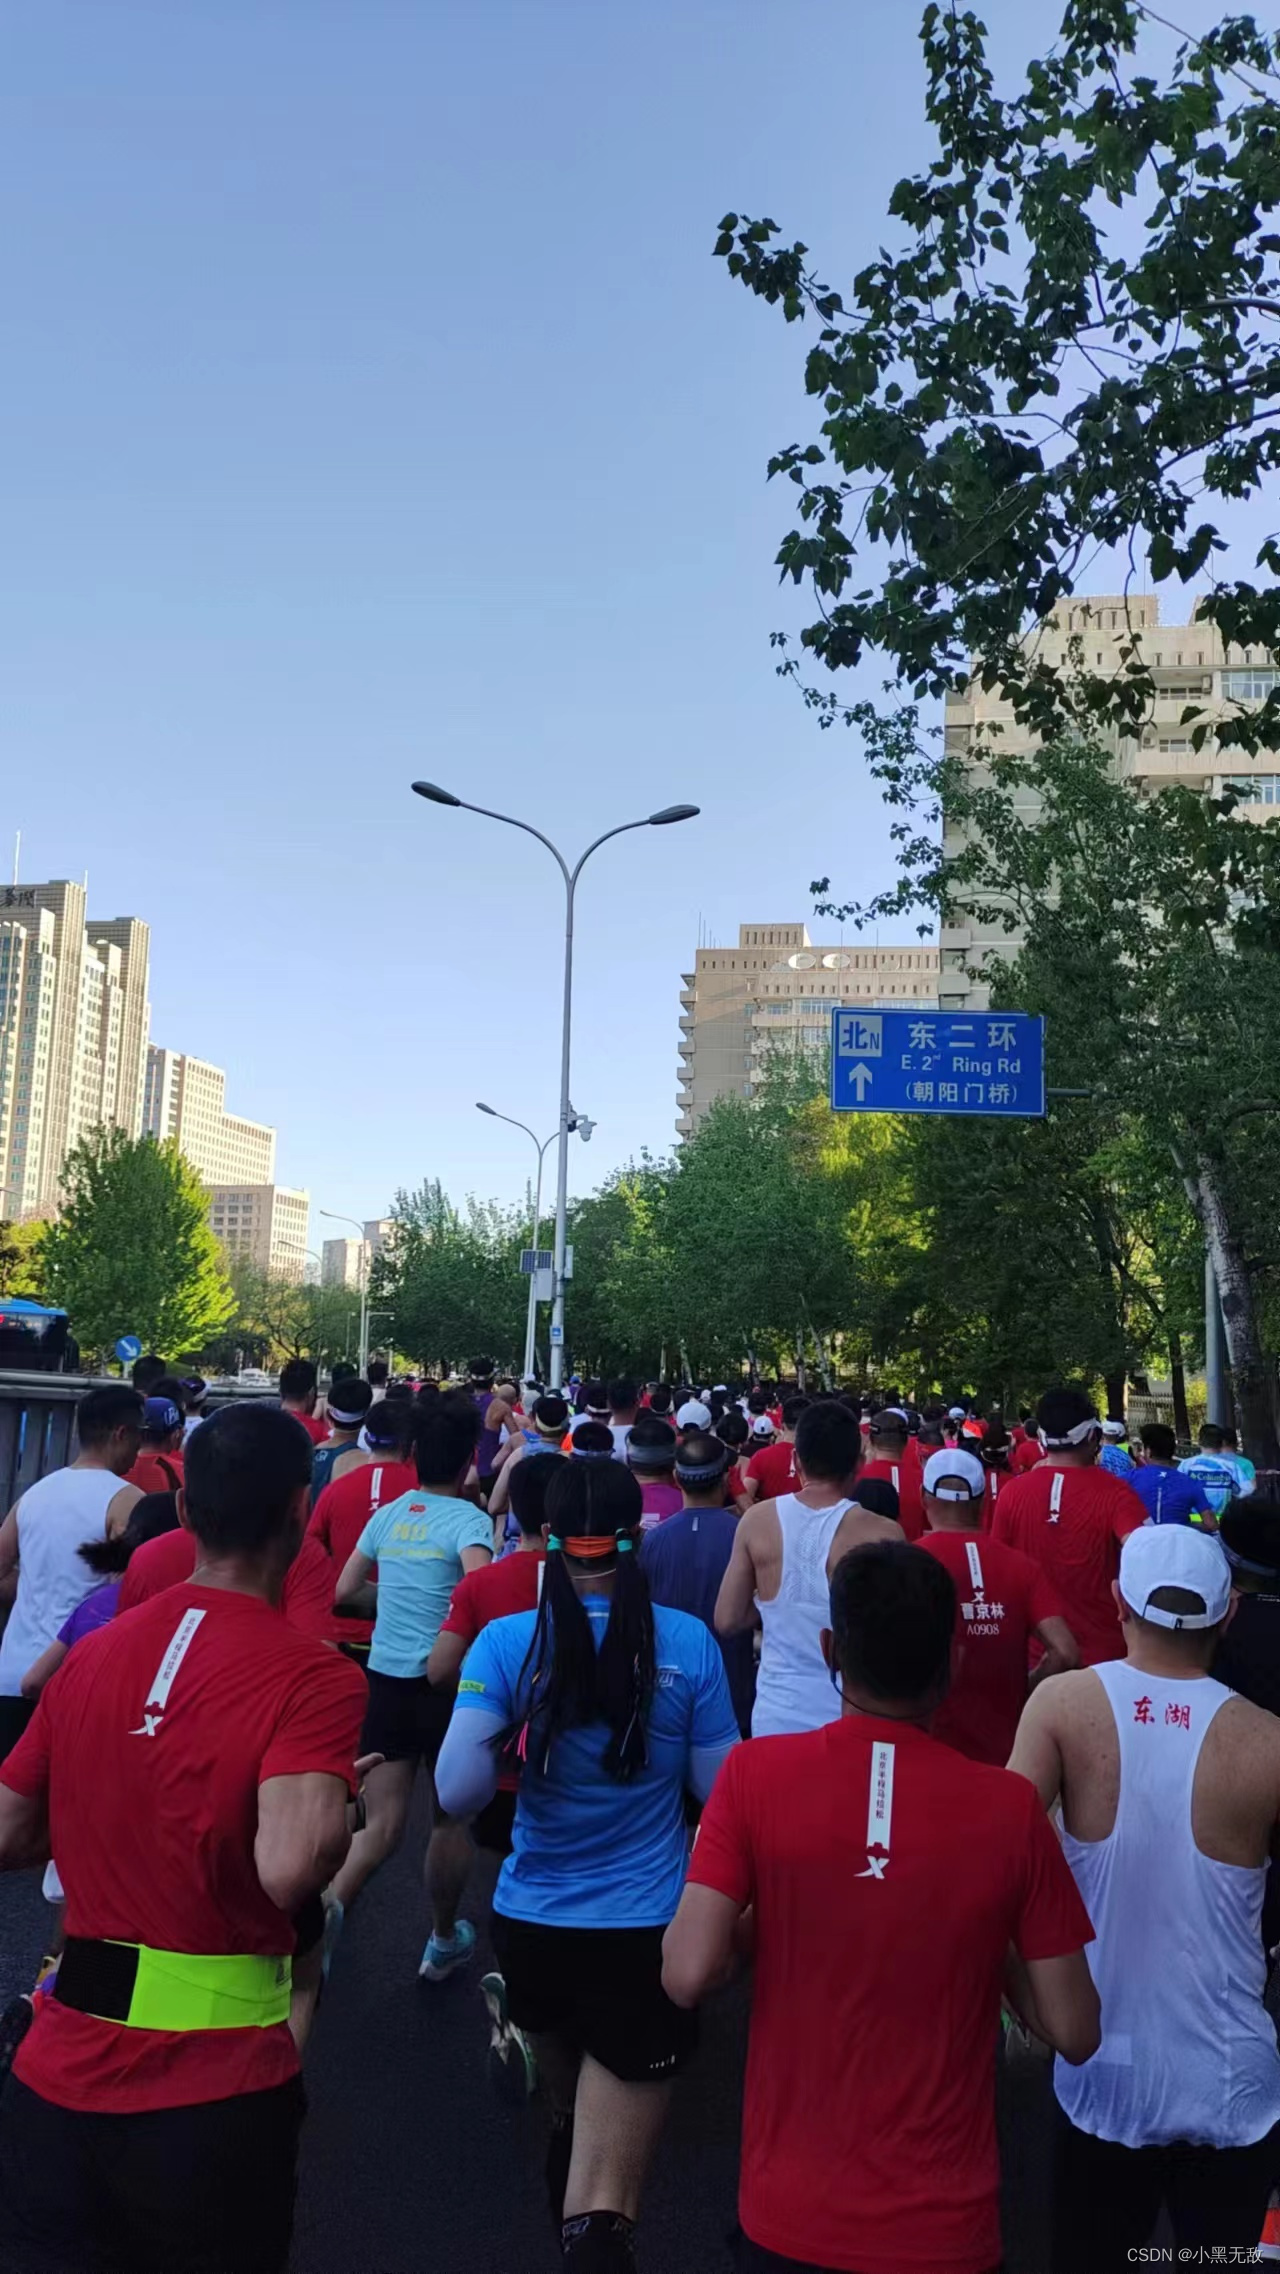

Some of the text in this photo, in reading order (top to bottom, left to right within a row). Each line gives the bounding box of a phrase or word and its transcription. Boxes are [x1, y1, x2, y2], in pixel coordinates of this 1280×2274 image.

[908, 1021, 1017, 1051] 东二环
[901, 1054, 917, 1070] E.
[952, 1057, 992, 1077] Ring
[997, 1058, 1021, 1074] Rd
[1133, 1695, 1191, 1731] 东湖
